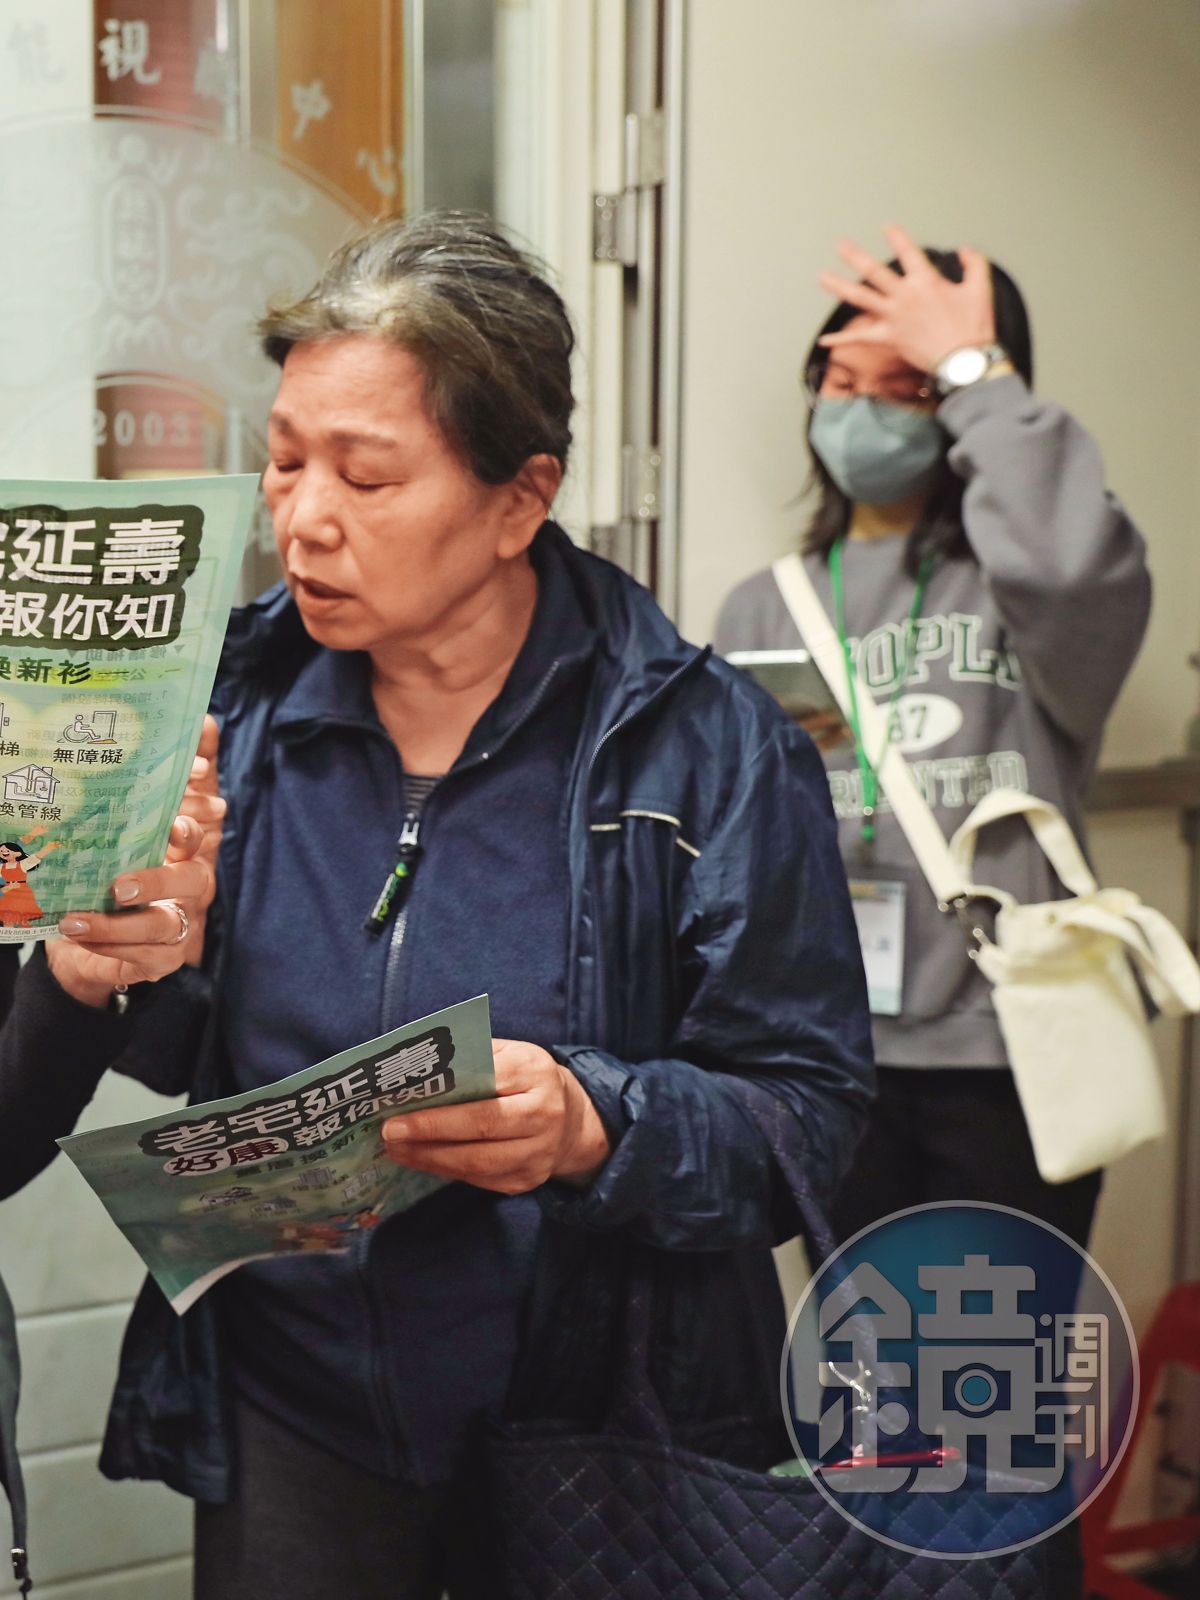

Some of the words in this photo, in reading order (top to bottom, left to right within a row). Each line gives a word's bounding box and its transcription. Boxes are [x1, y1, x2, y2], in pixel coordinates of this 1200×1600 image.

[94, 414, 191, 447] 2003
[53, 747, 124, 765] 無障礙
[153, 1036, 441, 1154] 老宅延壽
[168, 1076, 446, 1176] 好康報你知
